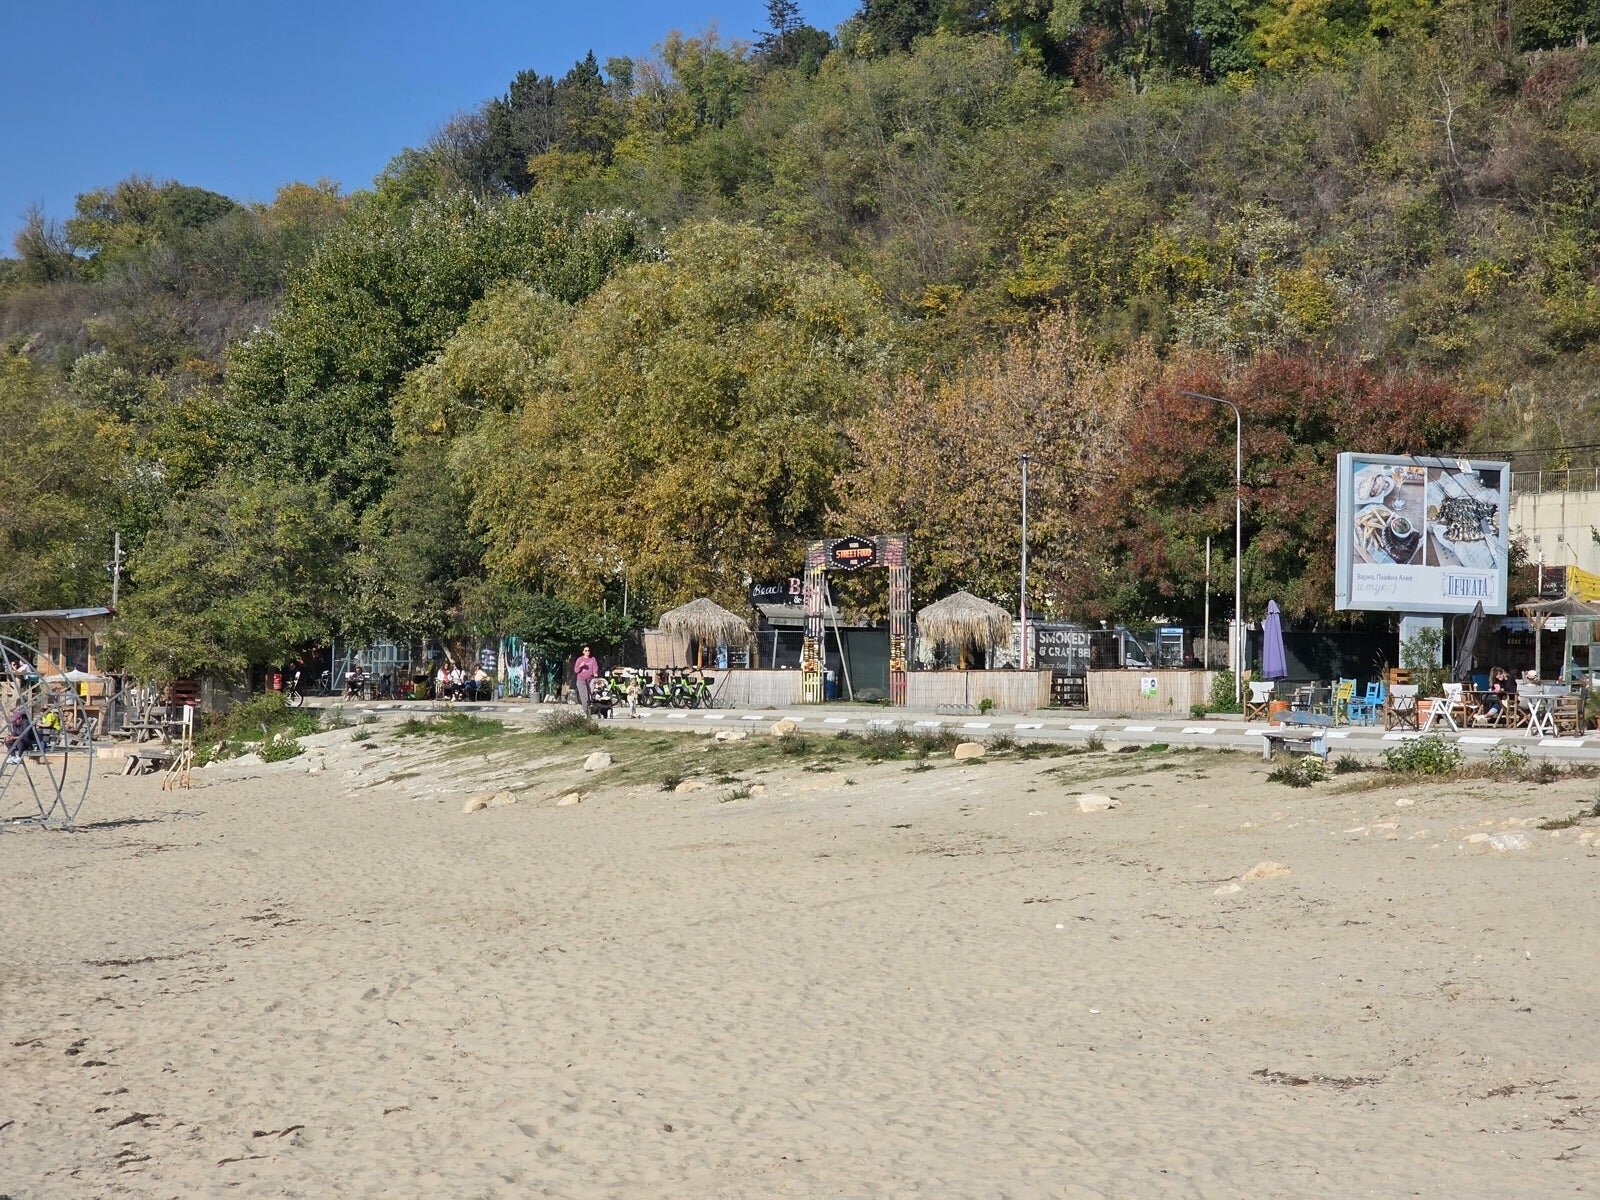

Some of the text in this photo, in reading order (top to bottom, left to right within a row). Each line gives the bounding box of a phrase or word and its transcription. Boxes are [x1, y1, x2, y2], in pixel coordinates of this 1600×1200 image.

[836, 548, 872, 559] STREET FOOD
[752, 582, 783, 597] Beach
[1448, 575, 1488, 596] ПЕЧКАТА
[1039, 632, 1085, 645] SMOKED
